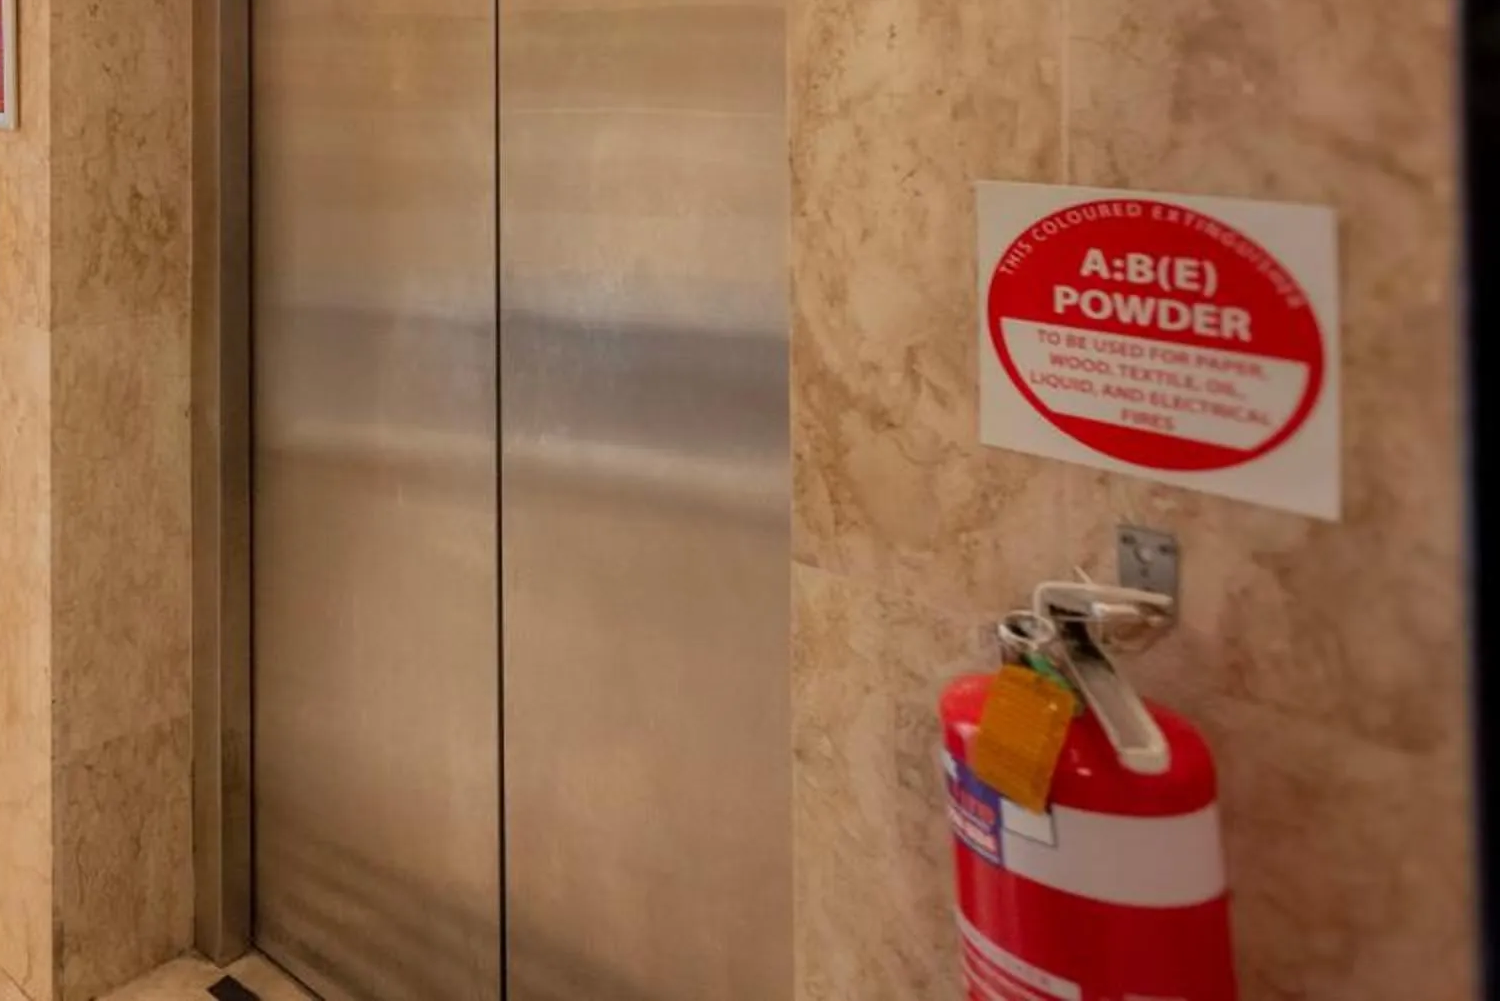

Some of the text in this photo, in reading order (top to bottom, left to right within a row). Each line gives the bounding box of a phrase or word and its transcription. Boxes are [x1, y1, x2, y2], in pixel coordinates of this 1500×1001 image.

[999, 240, 1033, 275] THIS
[1032, 202, 1143, 241] COLOURED
[1079, 247, 1218, 298] A:B(E)
[1053, 285, 1252, 342] POWDER
[1037, 328, 1061, 345] TO
[1065, 334, 1087, 349] BE
[1093, 339, 1144, 358] USED
[1148, 346, 1190, 365] FOR
[1102, 383, 1145, 402] AND
[1149, 391, 1272, 427] ELECTRICAL
